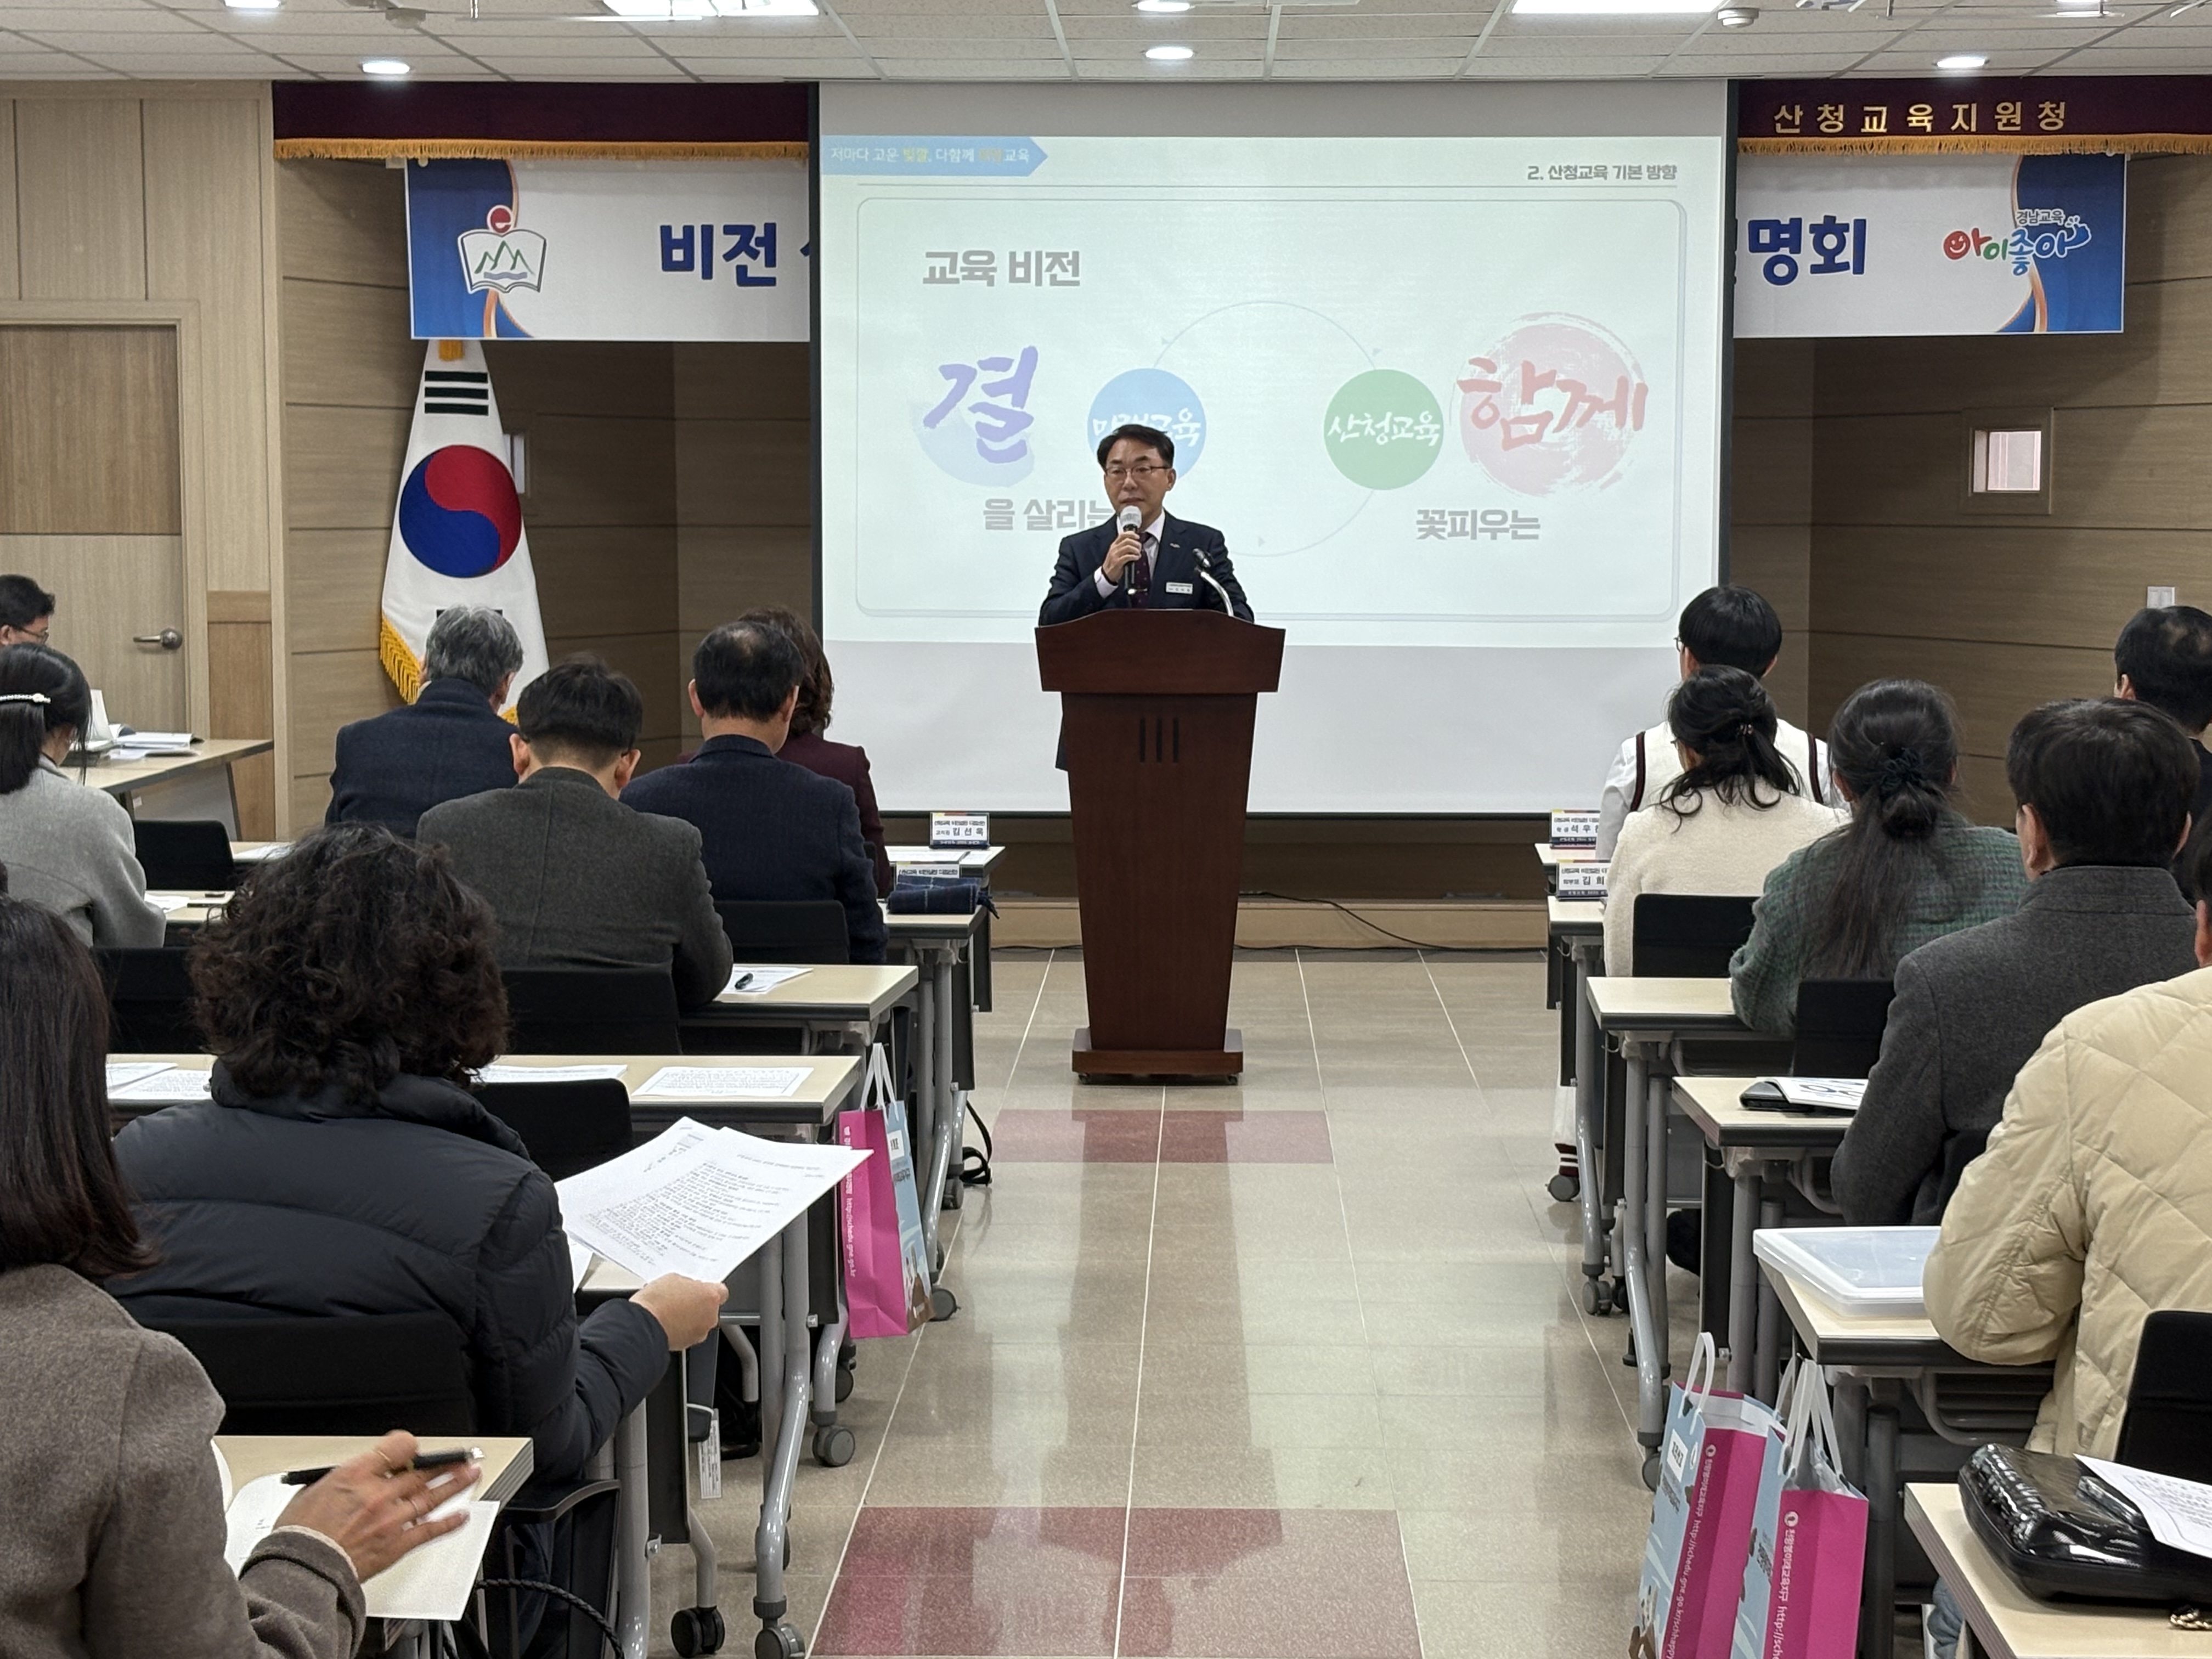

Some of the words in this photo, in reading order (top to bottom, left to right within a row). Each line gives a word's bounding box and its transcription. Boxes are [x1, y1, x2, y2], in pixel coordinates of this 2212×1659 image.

[1773, 101, 2066, 134] 산청교육지원청
[831, 148, 869, 162] 저마다
[872, 148, 899, 163] 고운
[935, 148, 974, 163] 다함께
[1527, 166, 1544, 180] 2.
[1548, 165, 1608, 180] 산청교육
[1613, 165, 1643, 180] 기본
[1646, 164, 1677, 180] 방향
[2016, 209, 2064, 225] 경남교육
[659, 222, 777, 287] 비전
[1748, 215, 1866, 286] 명회
[1943, 223, 2091, 276] 아이좋아
[923, 250, 997, 287] 교육
[1008, 250, 1080, 287] 비전
[923, 345, 1038, 464] 결
[1457, 357, 1649, 452] 함께
[1328, 410, 1441, 447] 산청교육
[983, 498, 1015, 531] 을
[1416, 509, 1541, 541] 꽃피우는
